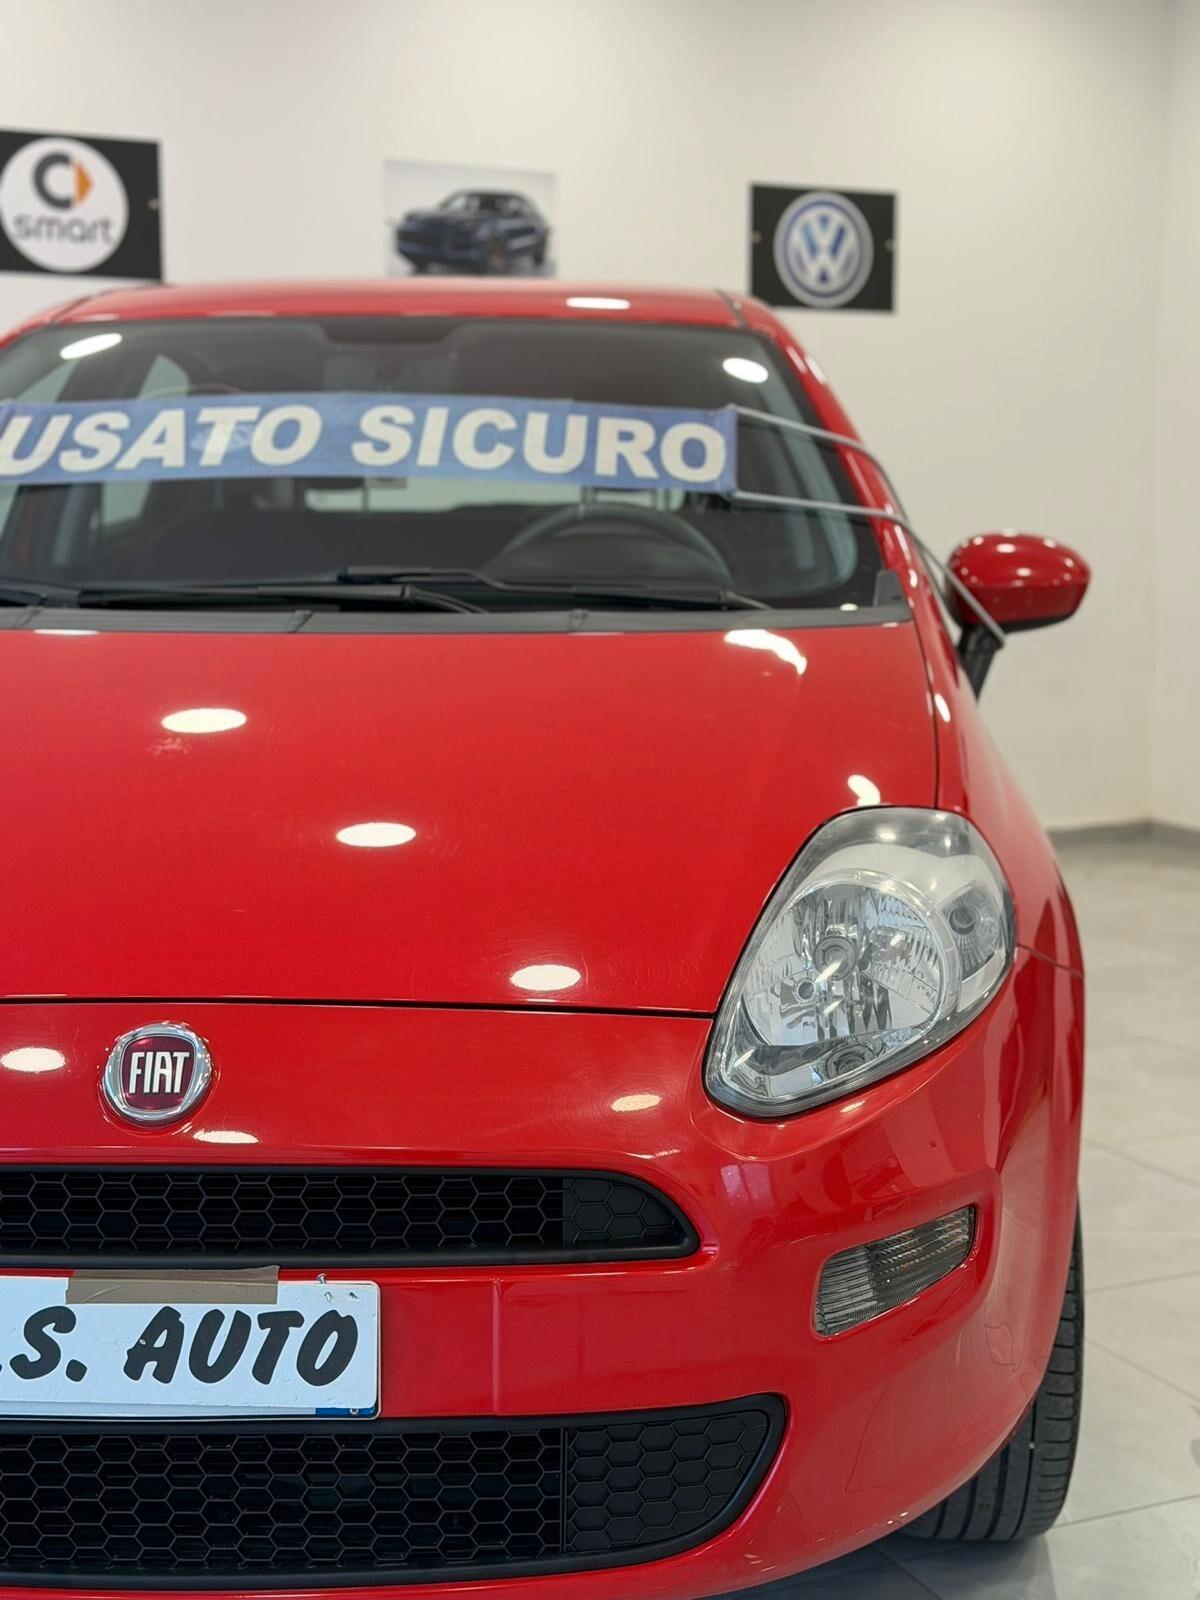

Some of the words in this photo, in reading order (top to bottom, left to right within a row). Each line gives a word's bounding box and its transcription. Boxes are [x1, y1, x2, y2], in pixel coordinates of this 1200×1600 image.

[14, 214, 113, 244] smart
[0, 405, 322, 476] USATO
[351, 405, 727, 483] SICURO
[129, 1051, 190, 1094] FIAT
[0, 1305, 88, 1383] S.
[123, 1305, 359, 1387] AUTO
